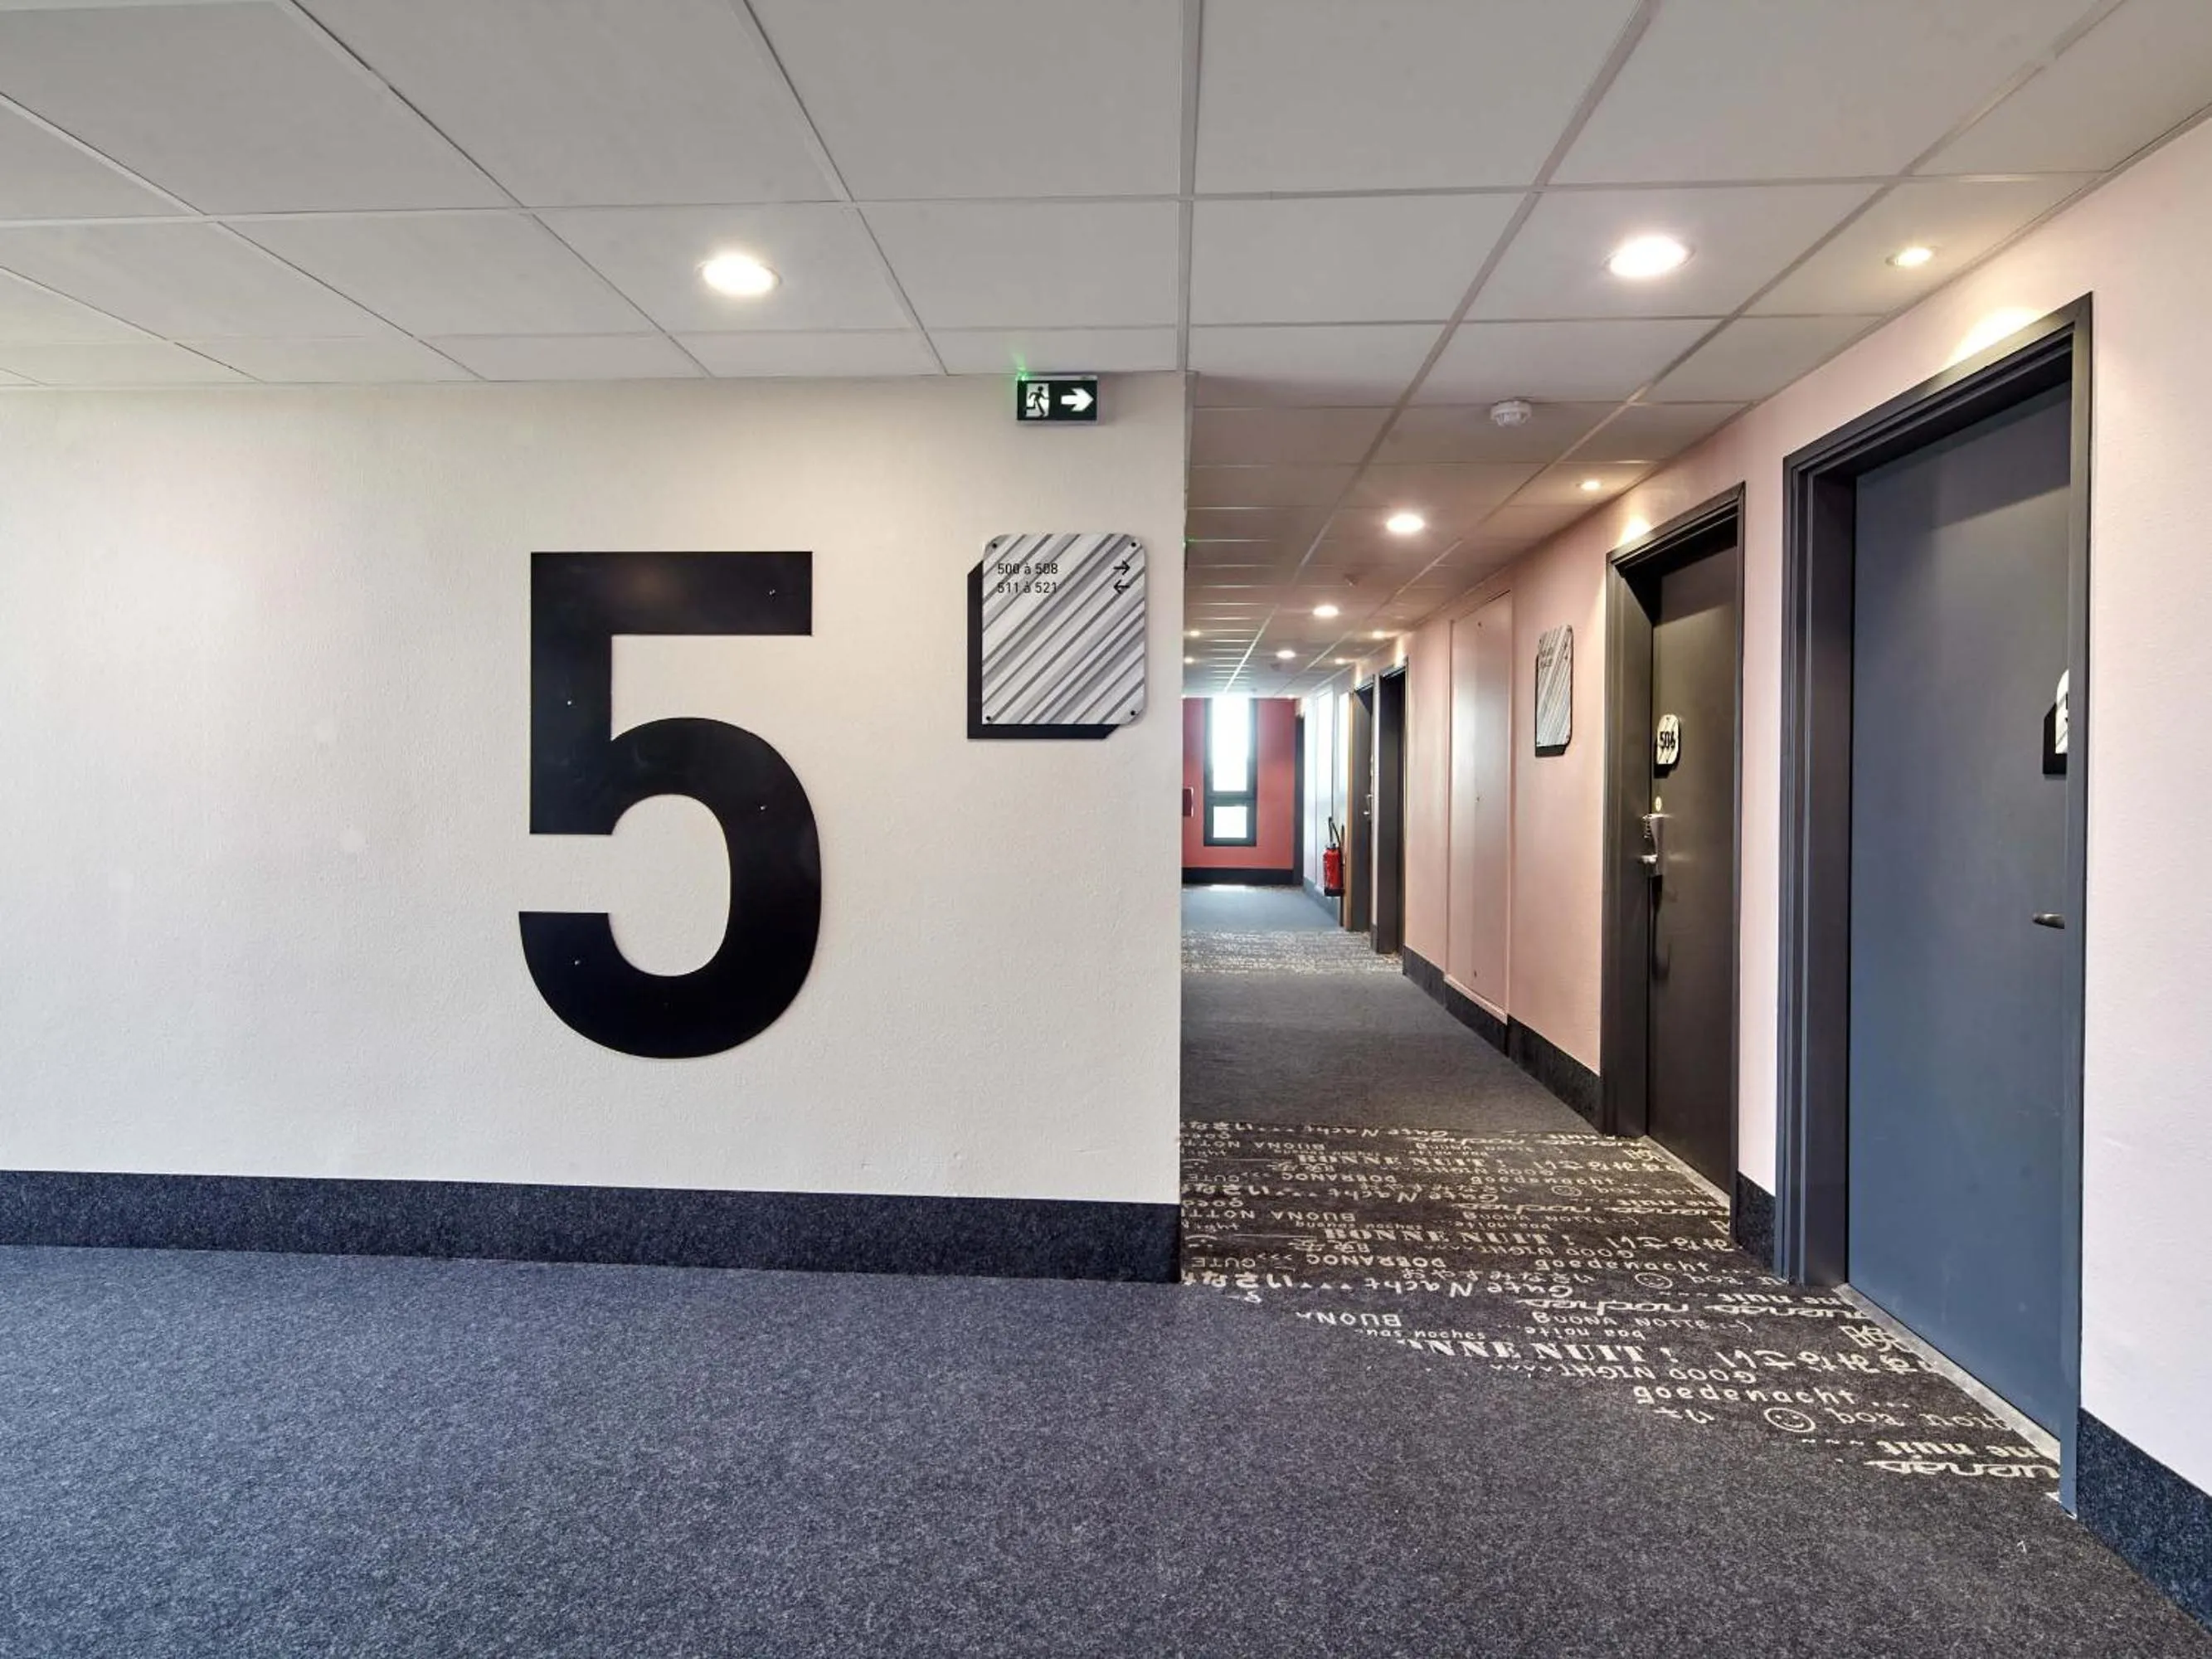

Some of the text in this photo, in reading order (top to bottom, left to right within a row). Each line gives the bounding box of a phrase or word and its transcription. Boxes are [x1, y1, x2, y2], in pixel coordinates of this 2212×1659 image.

[997, 562, 1020, 575] 500
[1035, 562, 1058, 575] 508
[997, 581, 1019, 594] 511
[1035, 581, 1058, 594] 521
[1659, 730, 1676, 748] 506
[518, 551, 822, 1059] 5
[1269, 1209, 1357, 1223] BUONA
[1324, 1228, 1450, 1243] BONNE
[1459, 1232, 1548, 1246] NUIT
[1305, 1253, 1446, 1267] DOBRANOC
[1534, 1258, 1710, 1272] goedenacht
[1363, 1277, 1574, 1299] Gute Nacht
[1514, 1297, 1689, 1316] noches
[1531, 1311, 1619, 1325] BUONA
[1414, 1328, 1487, 1340] noches
[1528, 1341, 1646, 1363] NUIT
[1668, 1368, 1757, 1384] GOOD
[1632, 1384, 1855, 1404] goedenacht
[1875, 1442, 1977, 1459] nuit
